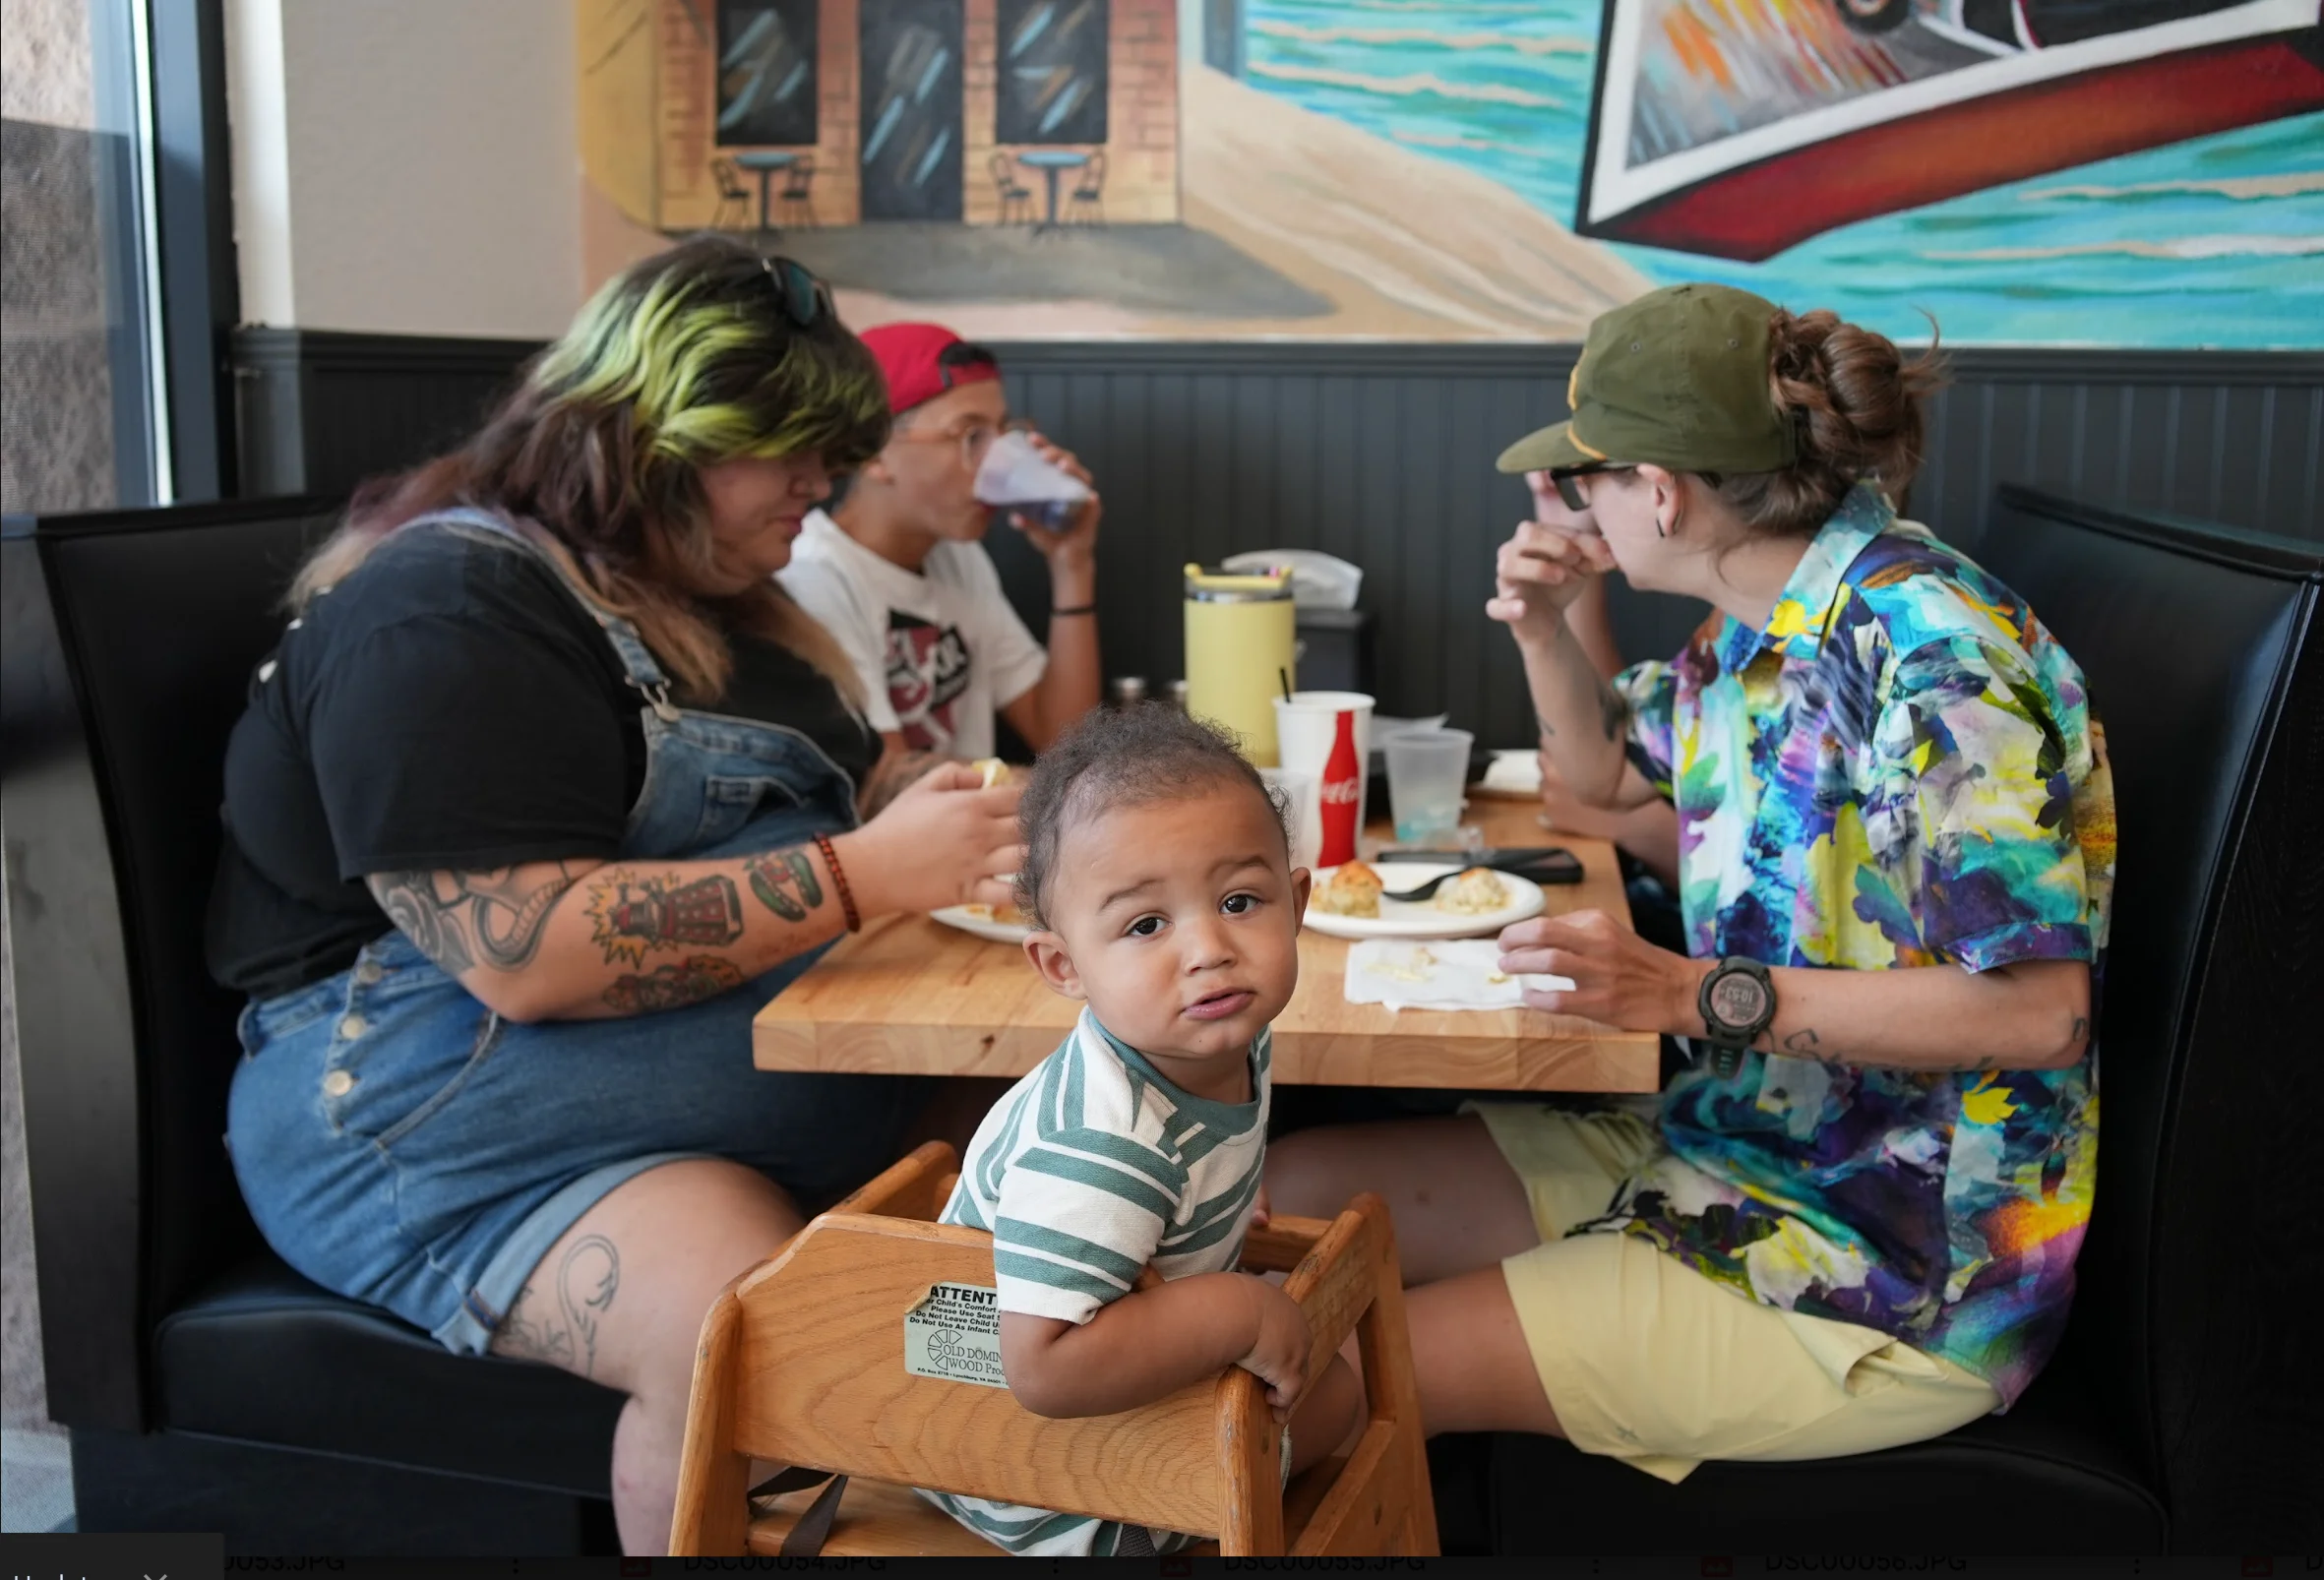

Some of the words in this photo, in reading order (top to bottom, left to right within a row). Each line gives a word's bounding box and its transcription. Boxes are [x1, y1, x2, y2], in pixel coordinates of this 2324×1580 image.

[931, 1286, 997, 1305] ATTENT
[931, 1306, 957, 1314] Please
[936, 1299, 962, 1308] Child's
[965, 1303, 997, 1312] Comfort
[945, 1314, 967, 1323] Leave
[967, 1325, 990, 1334] Infant
[944, 1345, 964, 1357] OLD
[967, 1348, 1002, 1363] DOMIN
[948, 1358, 983, 1372] WOOD
[985, 1363, 1005, 1375] Pro
